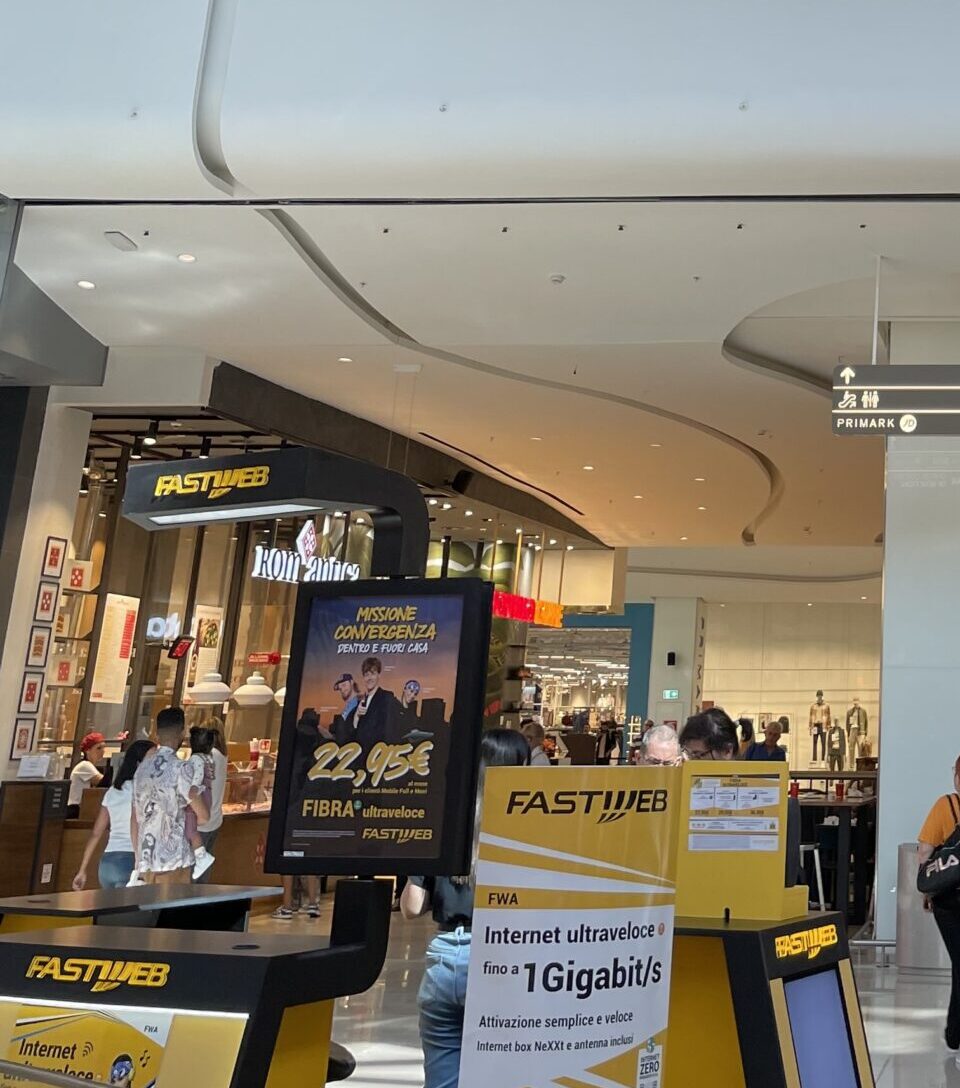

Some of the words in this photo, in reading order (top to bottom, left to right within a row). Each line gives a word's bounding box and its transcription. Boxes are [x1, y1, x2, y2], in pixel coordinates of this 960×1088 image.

[836, 418, 895, 429] PRIMARK
[154, 465, 270, 500] FASTWEB
[356, 606, 418, 622] MISSIONE
[334, 623, 437, 641] CONVERGENZA
[337, 643, 371, 654] DENTRO
[372, 643, 379, 653] E
[381, 643, 405, 654] FUORI
[407, 642, 429, 653] CASA
[307, 740, 434, 788] 22,95€
[302, 799, 355, 818] FIBRA
[362, 805, 425, 819] ultraveloce
[506, 789, 669, 824] FASTWEB
[362, 828, 433, 844] FASTWEB
[926, 853, 960, 878] FILA
[488, 892, 519, 905] FWA
[484, 925, 561, 945] Internet
[567, 920, 656, 944] ultraveloce
[775, 924, 838, 959] FASTWEB
[25, 955, 171, 993] FASTWEB
[482, 961, 509, 975] fino
[511, 964, 519, 975] a
[143, 1025, 159, 1034] FWA
[479, 1015, 542, 1029] Attivazione
[545, 1013, 594, 1030] semplice
[596, 1017, 603, 1026] e
[605, 1010, 634, 1025] veloce
[18, 1038, 77, 1060] Internet
[476, 1040, 512, 1052] Internet
[514, 1040, 532, 1053] box
[534, 1040, 564, 1052] NeXXt
[566, 1042, 572, 1051] e
[574, 1038, 609, 1051] antenna
[610, 1032, 634, 1047] inclusi
[640, 1060, 660, 1075] ZERO
